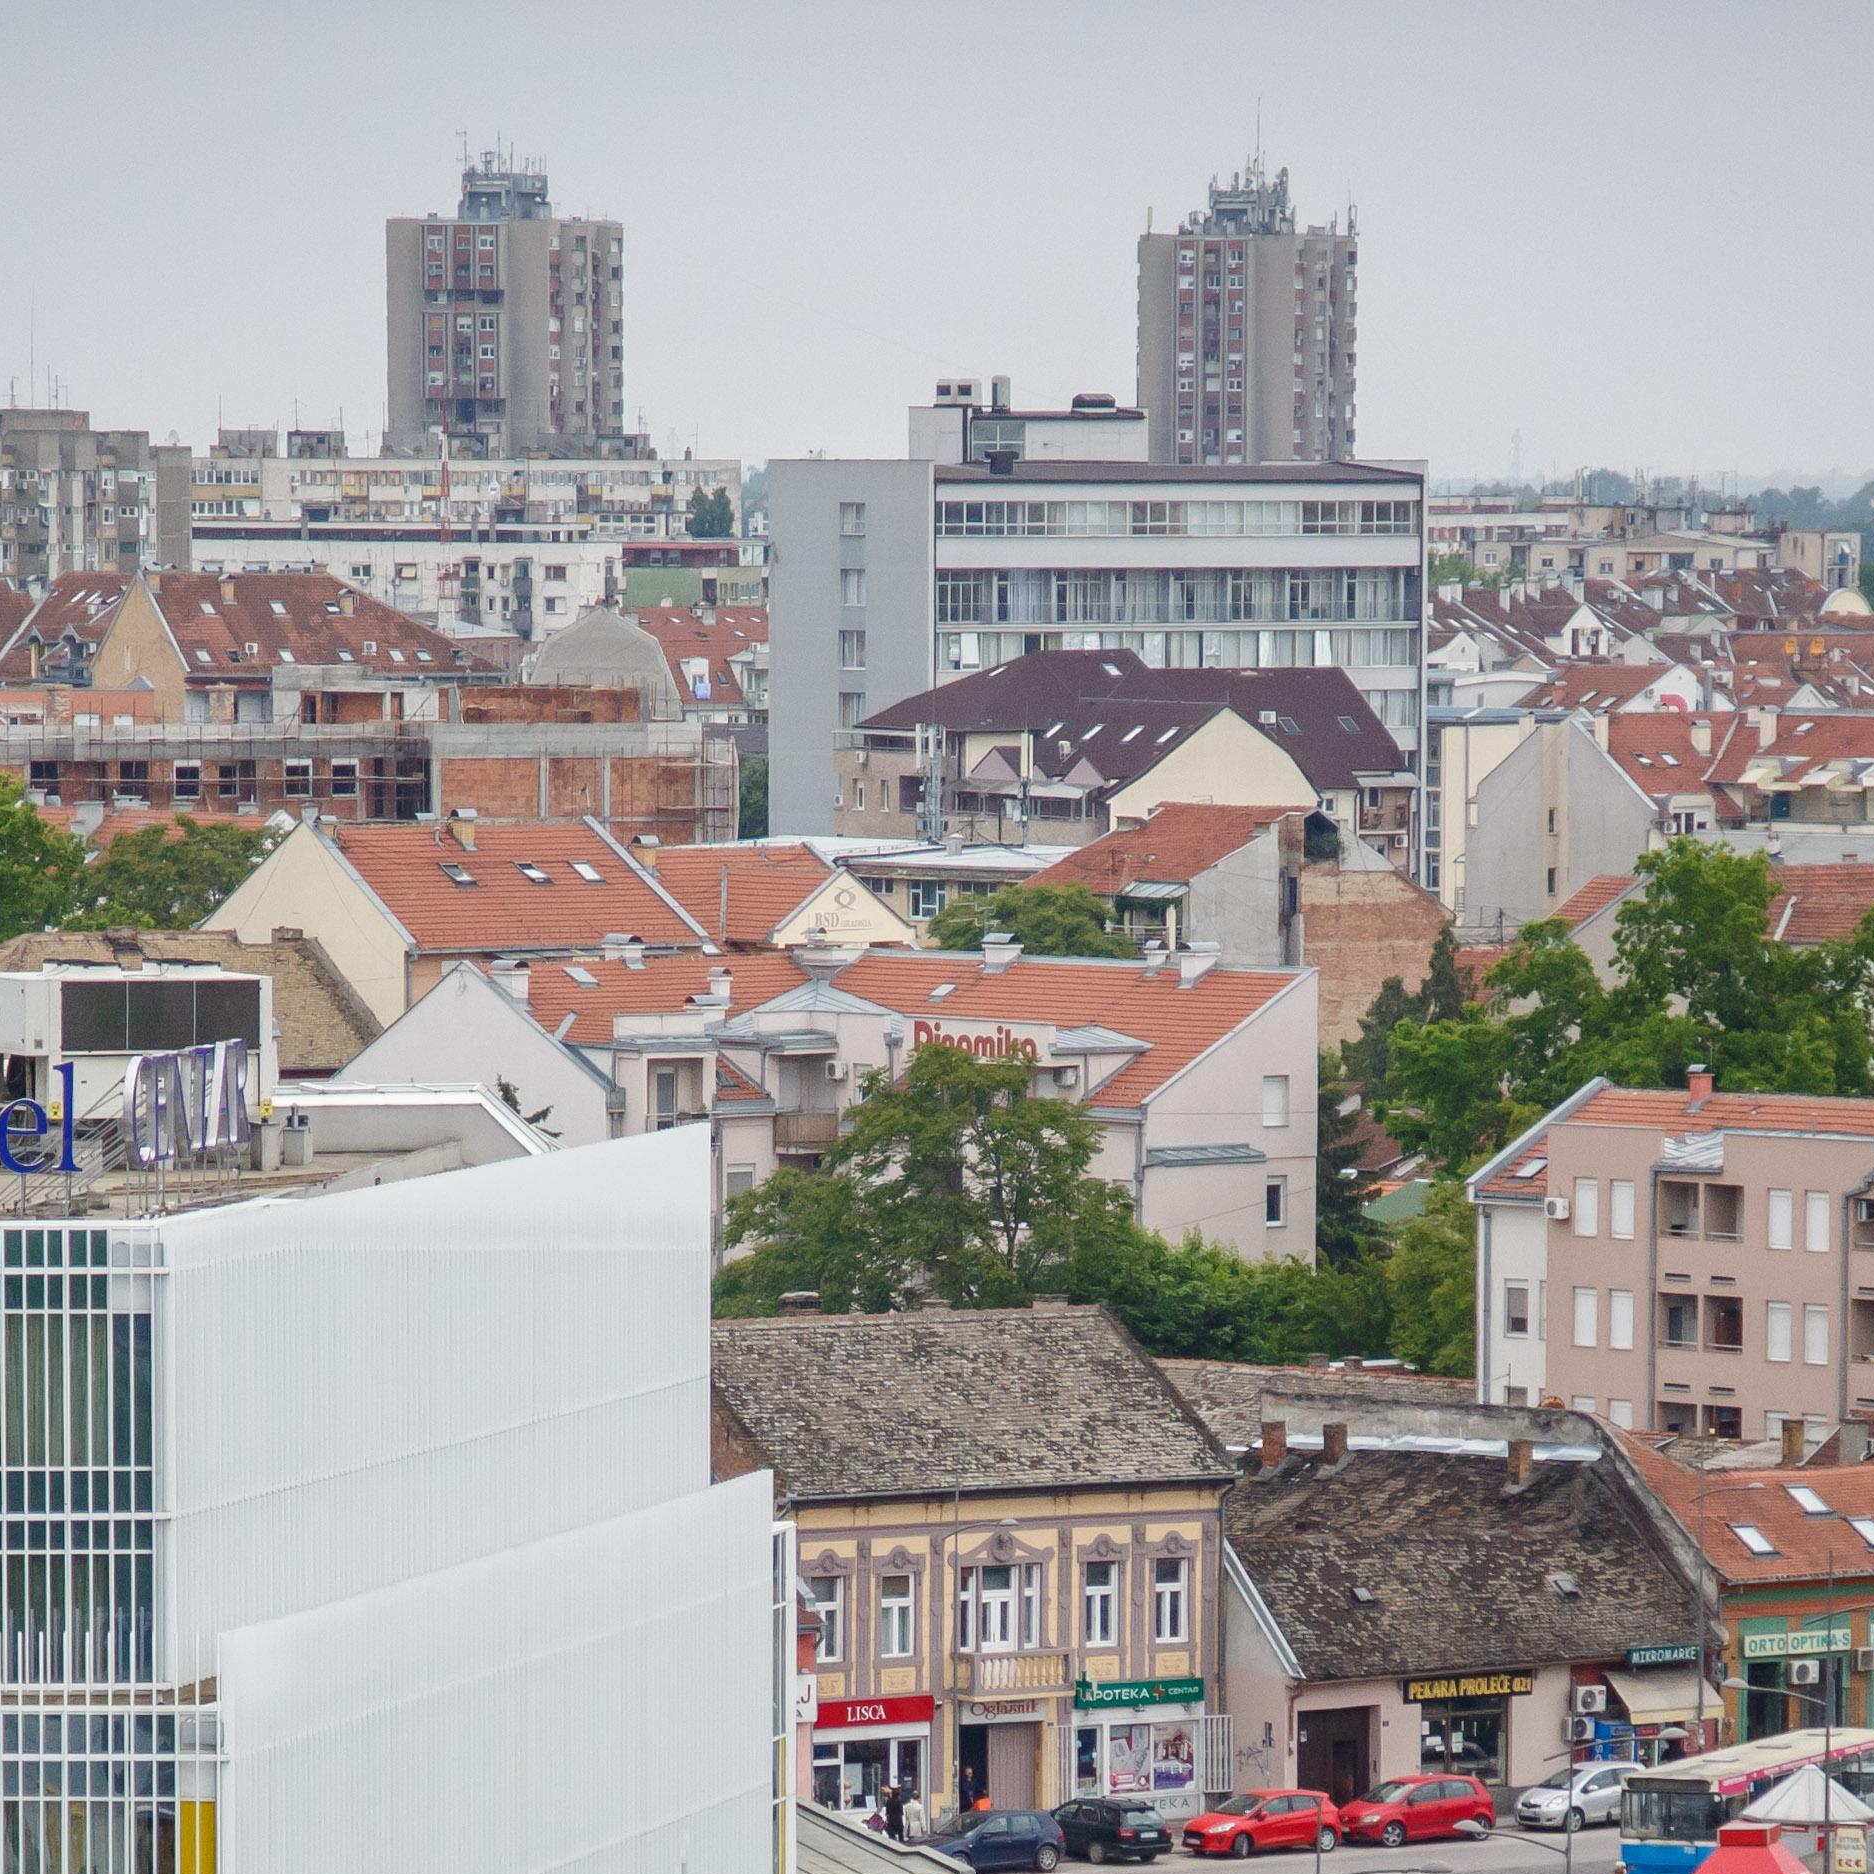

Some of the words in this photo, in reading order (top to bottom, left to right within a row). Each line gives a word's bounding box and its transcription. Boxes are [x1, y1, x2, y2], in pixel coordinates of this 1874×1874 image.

[814, 911, 840, 928] BSD
[1748, 1637, 1786, 1653] ORTO
[1630, 1646, 1701, 1664] MIKROMARKE
[1408, 1680, 1458, 1700] PEKARA
[846, 1704, 887, 1722] LISCA
